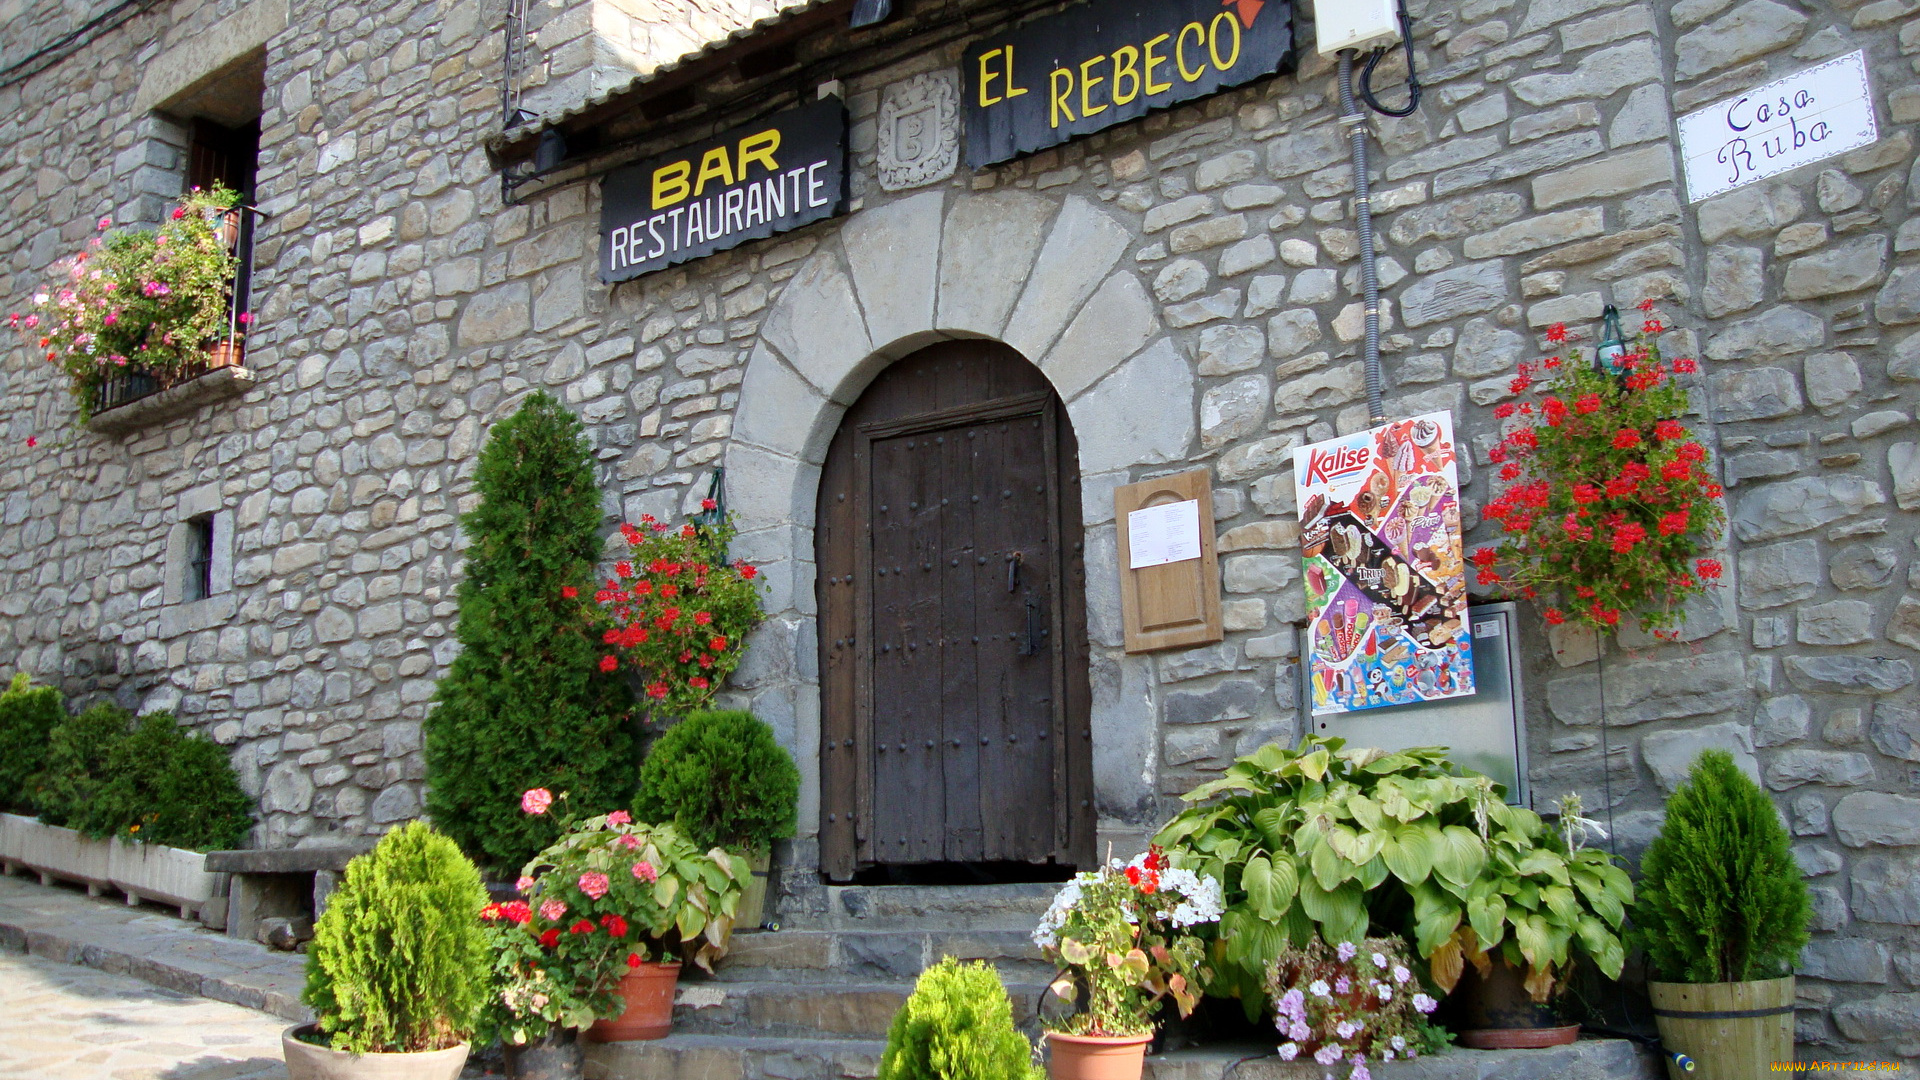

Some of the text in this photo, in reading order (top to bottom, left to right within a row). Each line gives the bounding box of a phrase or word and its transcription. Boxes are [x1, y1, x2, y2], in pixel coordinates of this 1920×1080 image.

[979, 11, 1240, 128] EL REBECO
[1727, 89, 1814, 132] Casa
[652, 129, 781, 210] BAR
[1716, 116, 1832, 183] Ruba
[611, 160, 828, 270] RESTAURANTE
[1305, 446, 1370, 488] Kalise
